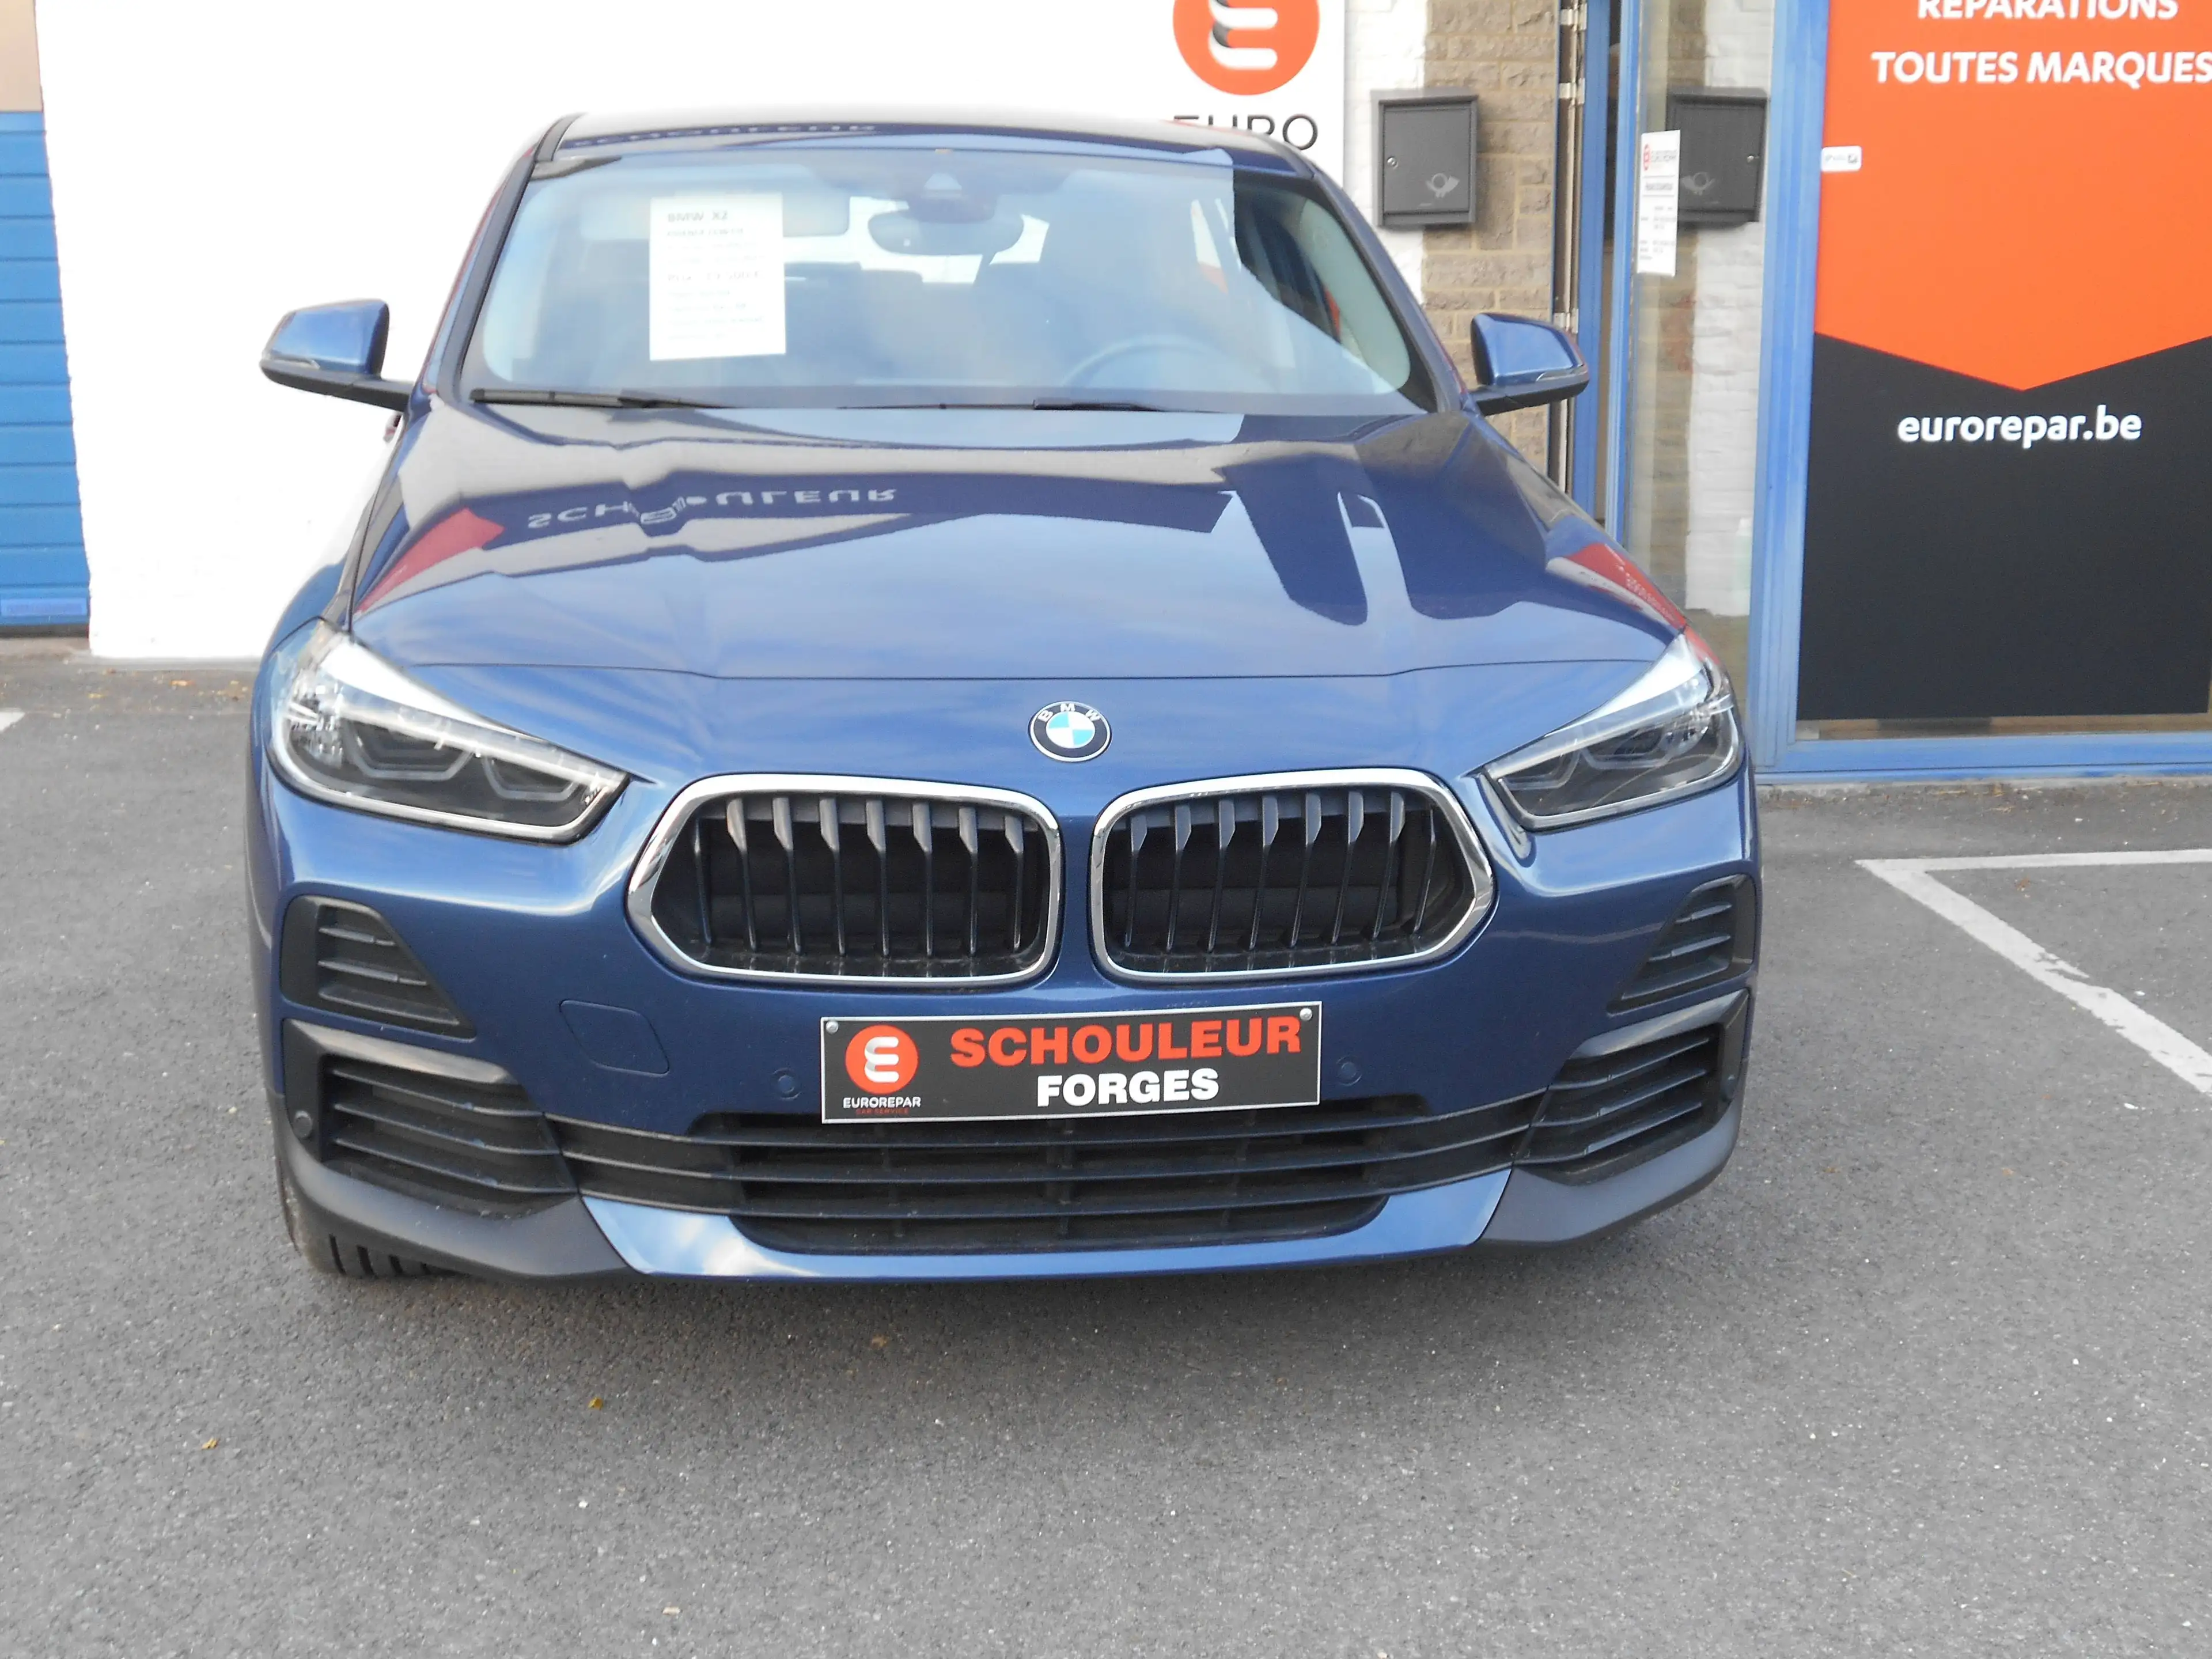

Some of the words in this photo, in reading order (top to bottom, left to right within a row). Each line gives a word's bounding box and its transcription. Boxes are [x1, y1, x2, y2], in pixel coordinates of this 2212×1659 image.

[1870, 51, 2019, 84] TOUTES
[2026, 51, 2212, 90] MARQUES
[1897, 404, 2142, 449] eurorepar.be
[1037, 703, 1101, 722] BMW
[950, 1016, 1301, 1067] SCHOULEUR
[843, 1096, 922, 1109] EUROREPAR
[1037, 1069, 1219, 1107] FORGES
